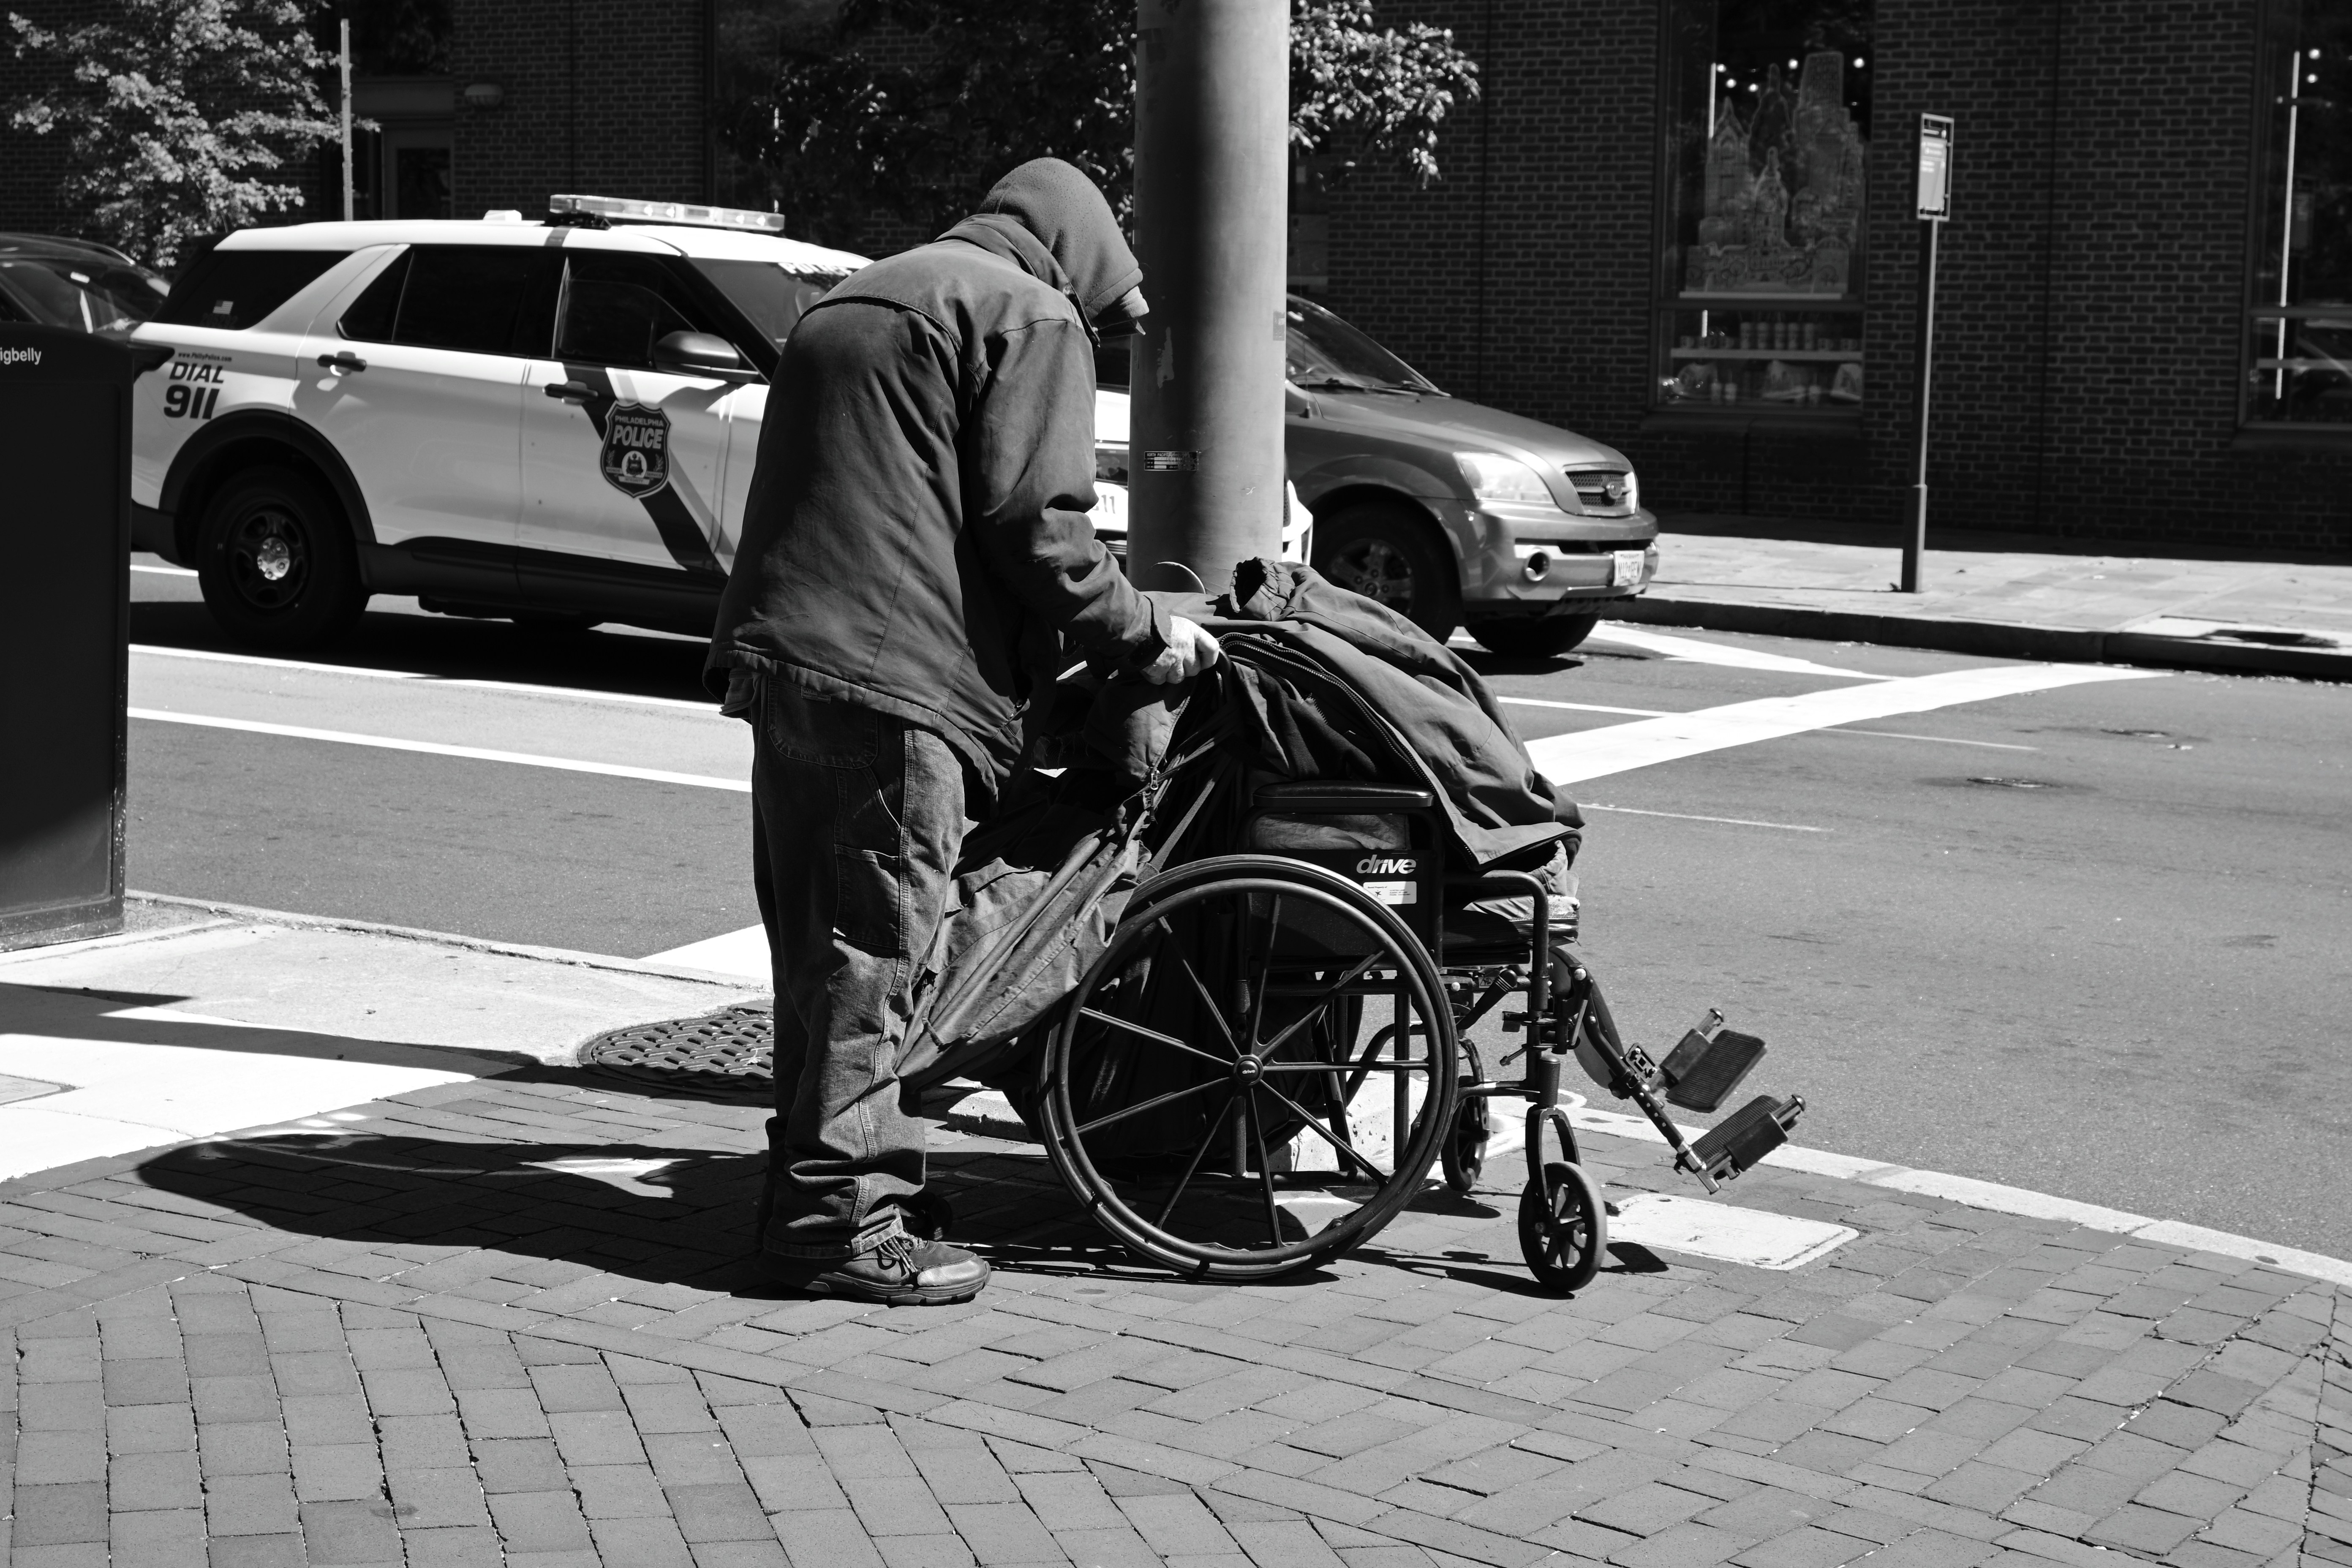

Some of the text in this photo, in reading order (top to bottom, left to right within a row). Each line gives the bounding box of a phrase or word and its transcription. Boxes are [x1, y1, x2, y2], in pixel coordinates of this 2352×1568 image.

[0, 347, 41, 365] igbelly
[169, 362, 224, 384] DIAL
[163, 384, 220, 420] 911
[615, 415, 664, 427] PHILADELPHIA
[612, 425, 664, 449] POLICE
[1092, 495, 1115, 514] 11
[1356, 854, 1416, 874] drive
